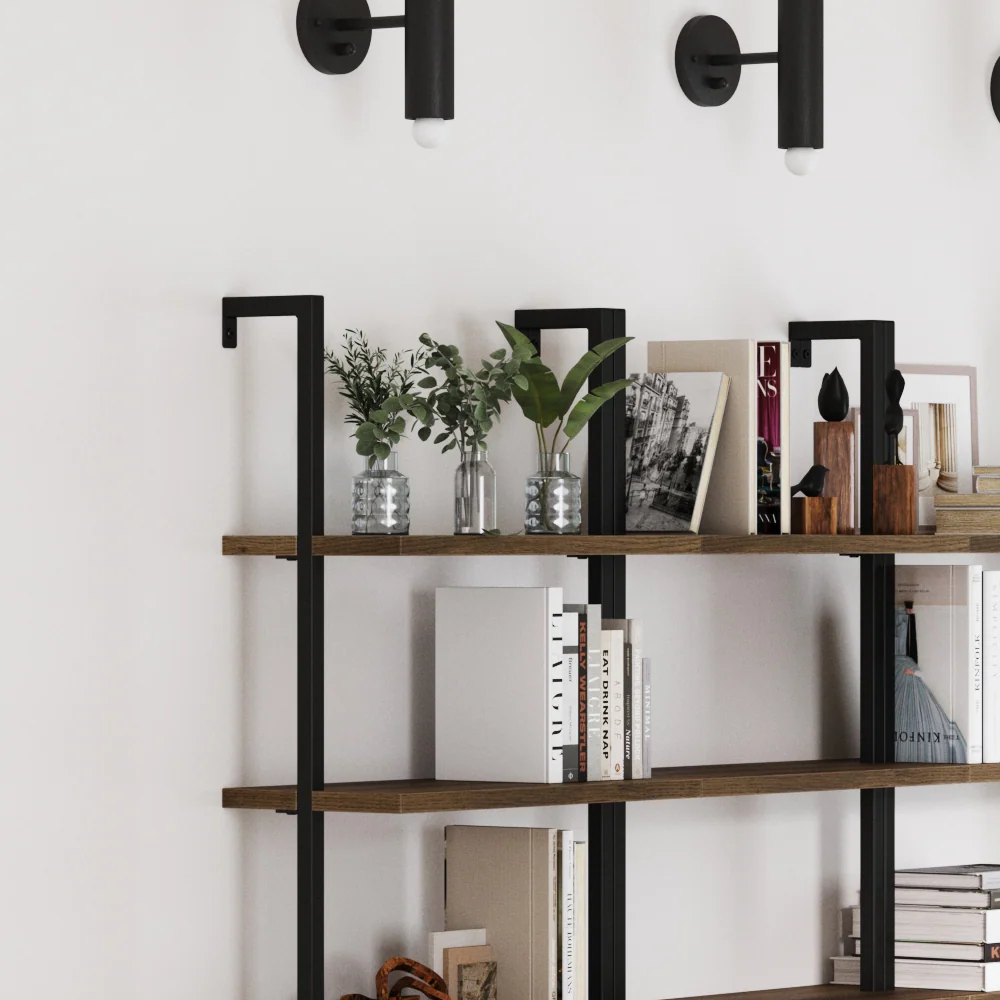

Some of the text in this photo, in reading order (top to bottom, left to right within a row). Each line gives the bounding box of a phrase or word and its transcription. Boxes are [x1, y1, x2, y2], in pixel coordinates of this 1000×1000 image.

[579, 621, 587, 773] KELLY WEARSTLER
[588, 649, 601, 738] LIAIGRE
